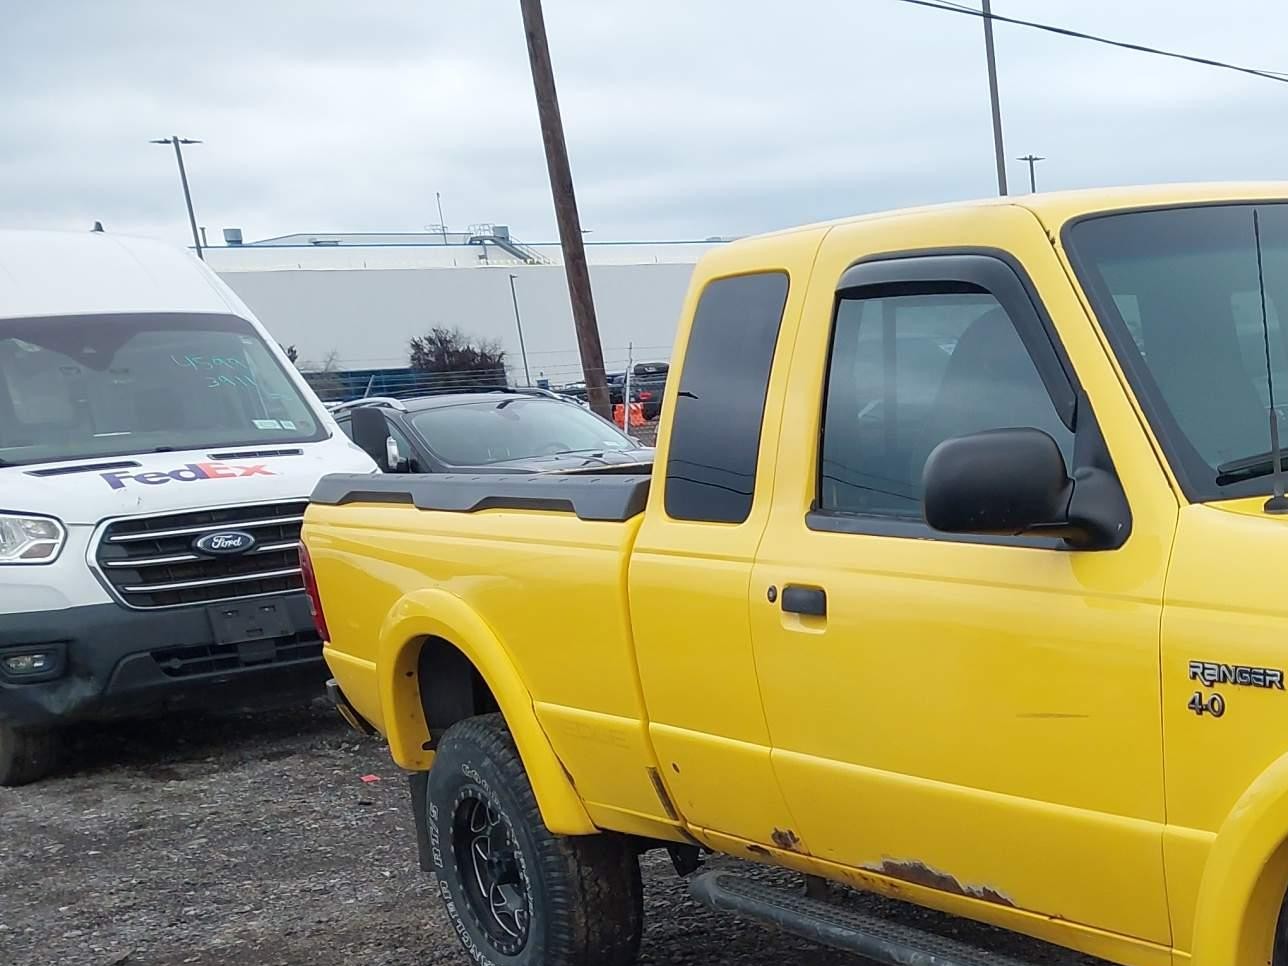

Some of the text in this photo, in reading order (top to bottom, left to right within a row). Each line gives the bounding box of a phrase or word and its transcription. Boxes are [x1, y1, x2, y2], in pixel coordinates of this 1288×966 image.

[99, 461, 277, 491] FedEx
[210, 534, 244, 550] Ford
[1188, 660, 1287, 691] RANGER
